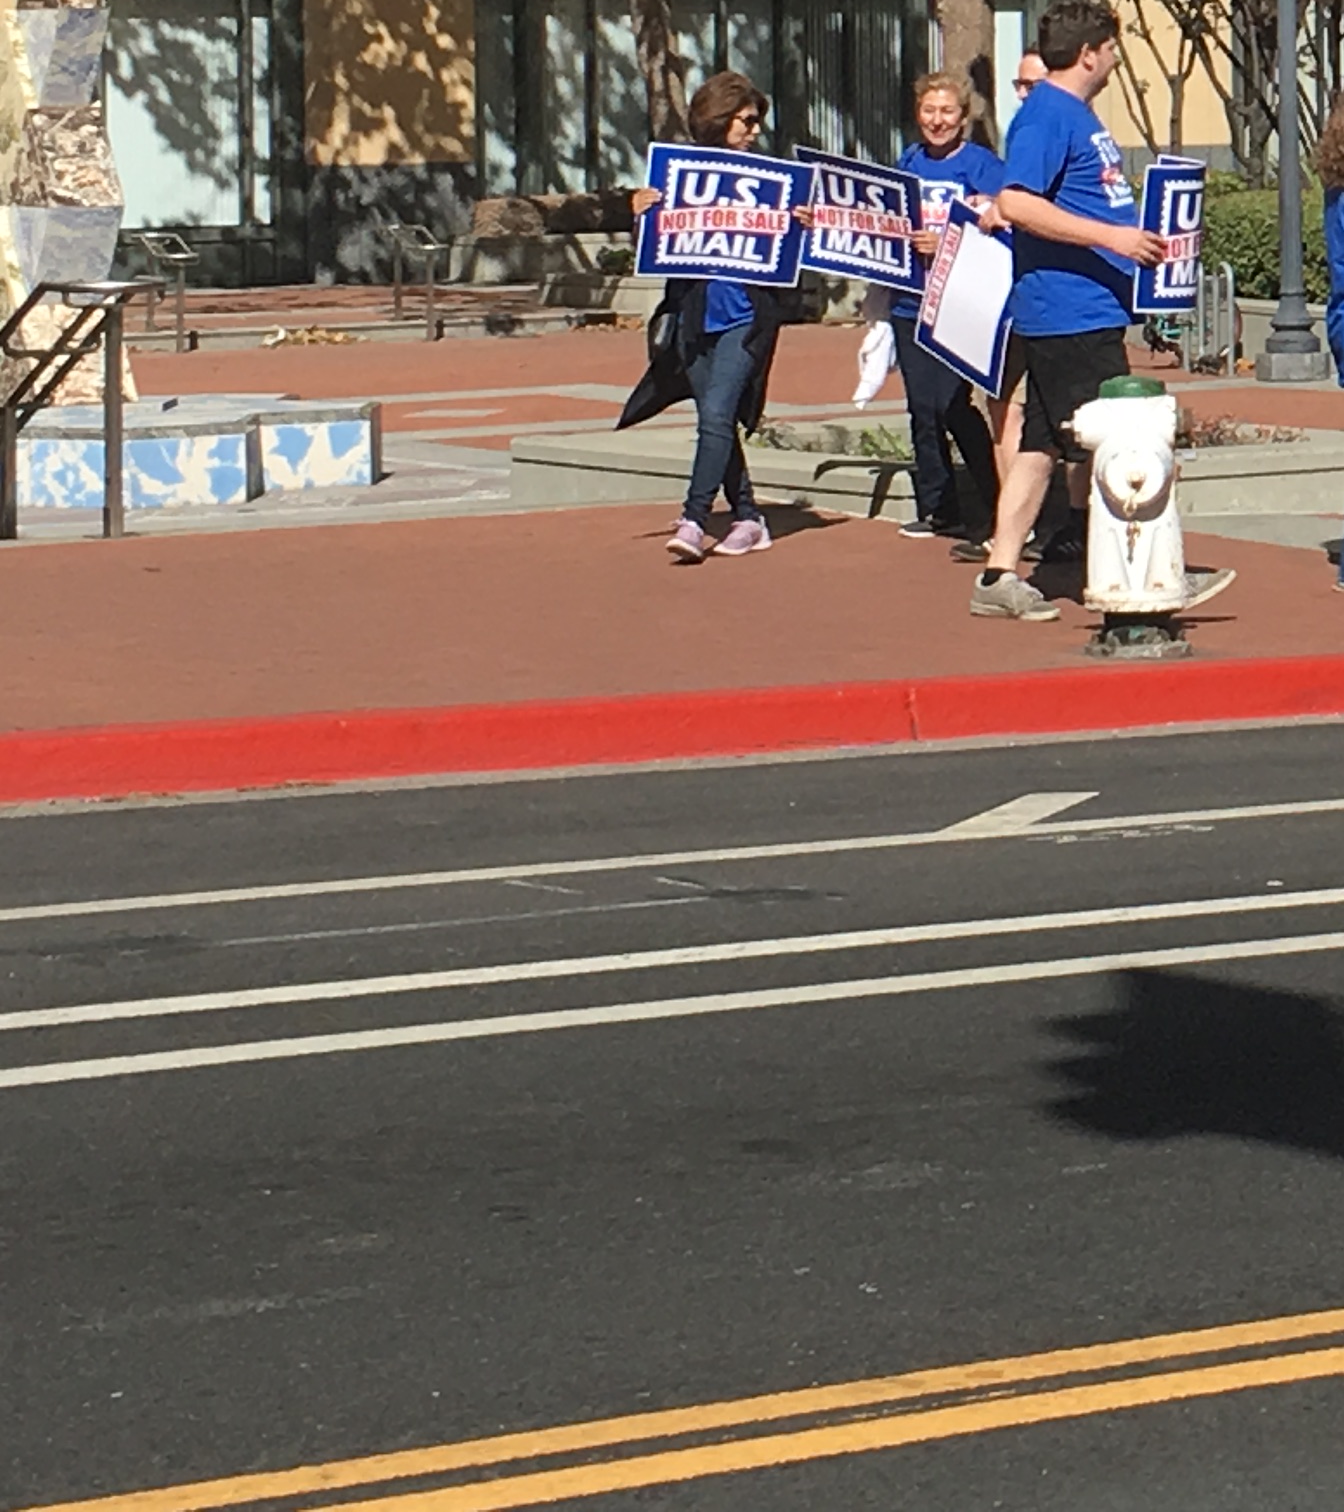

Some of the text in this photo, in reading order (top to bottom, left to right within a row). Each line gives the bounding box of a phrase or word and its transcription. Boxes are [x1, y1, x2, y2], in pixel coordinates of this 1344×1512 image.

[682, 171, 771, 210] U.S.
[828, 173, 897, 217] U.S.
[662, 209, 786, 231] NOT FOR SALE
[815, 207, 910, 235] NOT FOR SALE
[672, 231, 764, 262] MAIL
[826, 229, 901, 266] MAIL
